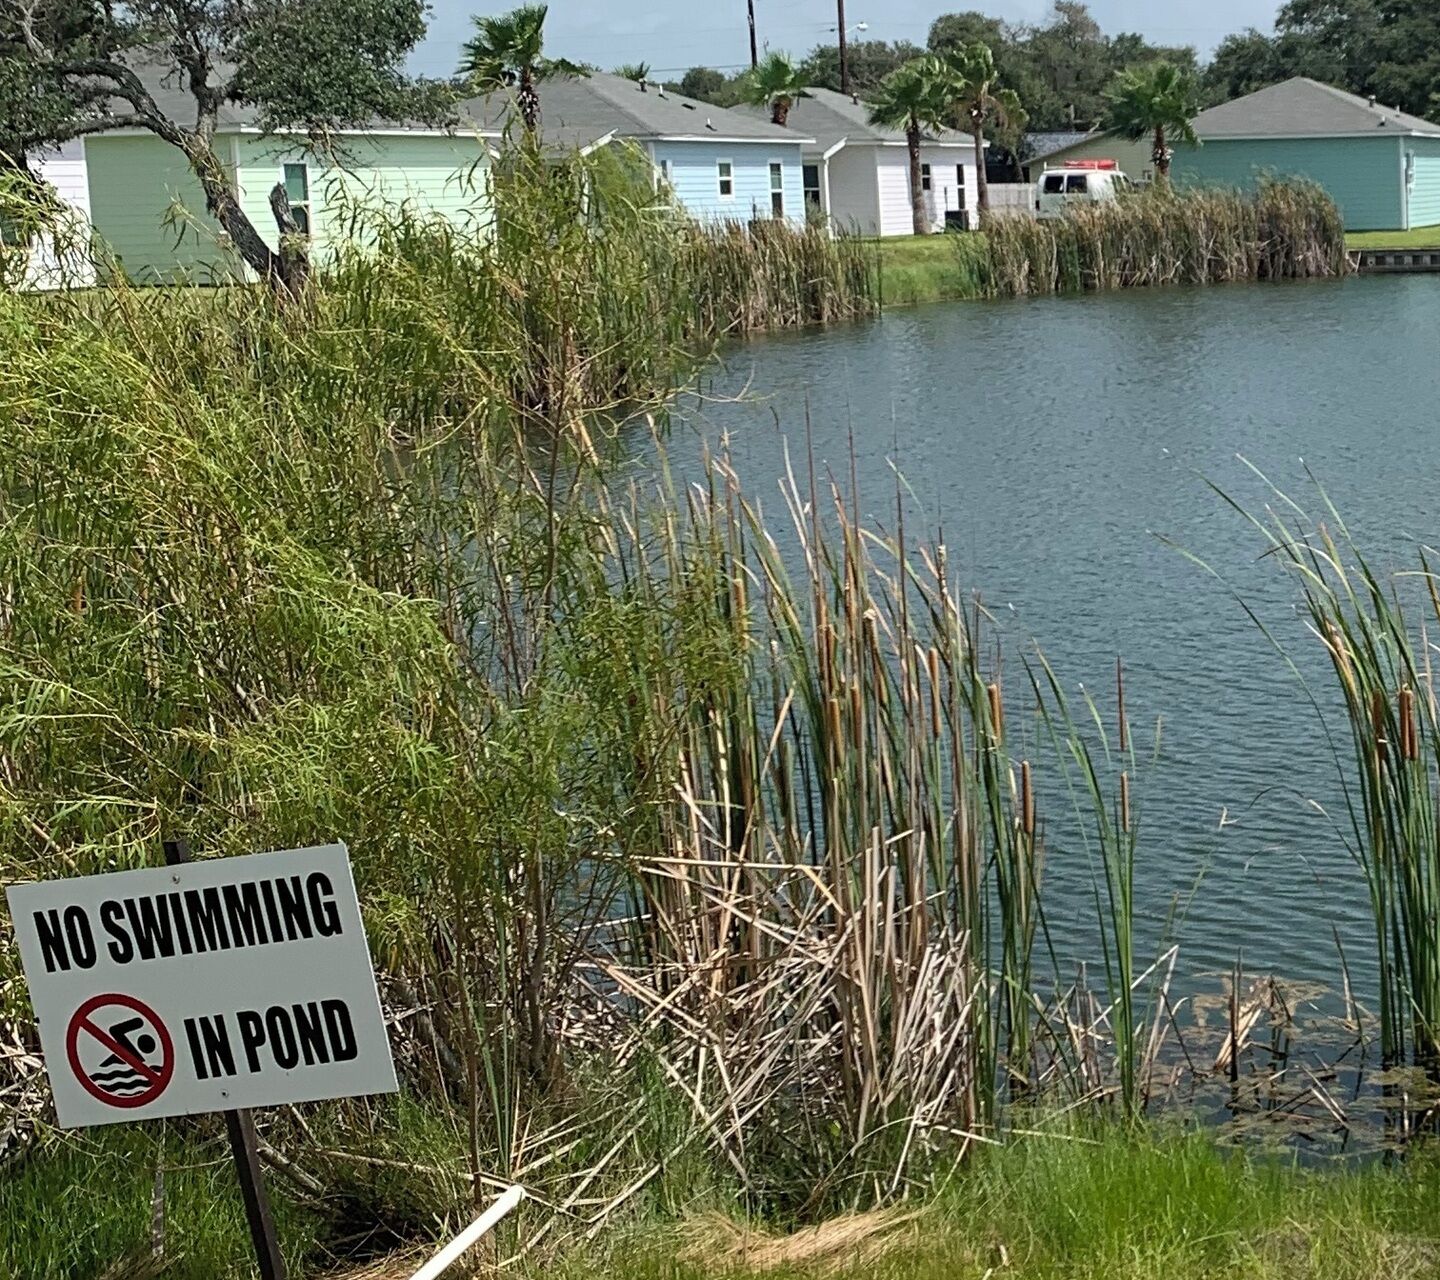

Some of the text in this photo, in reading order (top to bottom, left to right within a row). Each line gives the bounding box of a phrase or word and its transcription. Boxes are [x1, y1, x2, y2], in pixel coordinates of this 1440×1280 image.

[33, 871, 343, 974] NO SWIMMING
[183, 999, 358, 1080] IN POND
